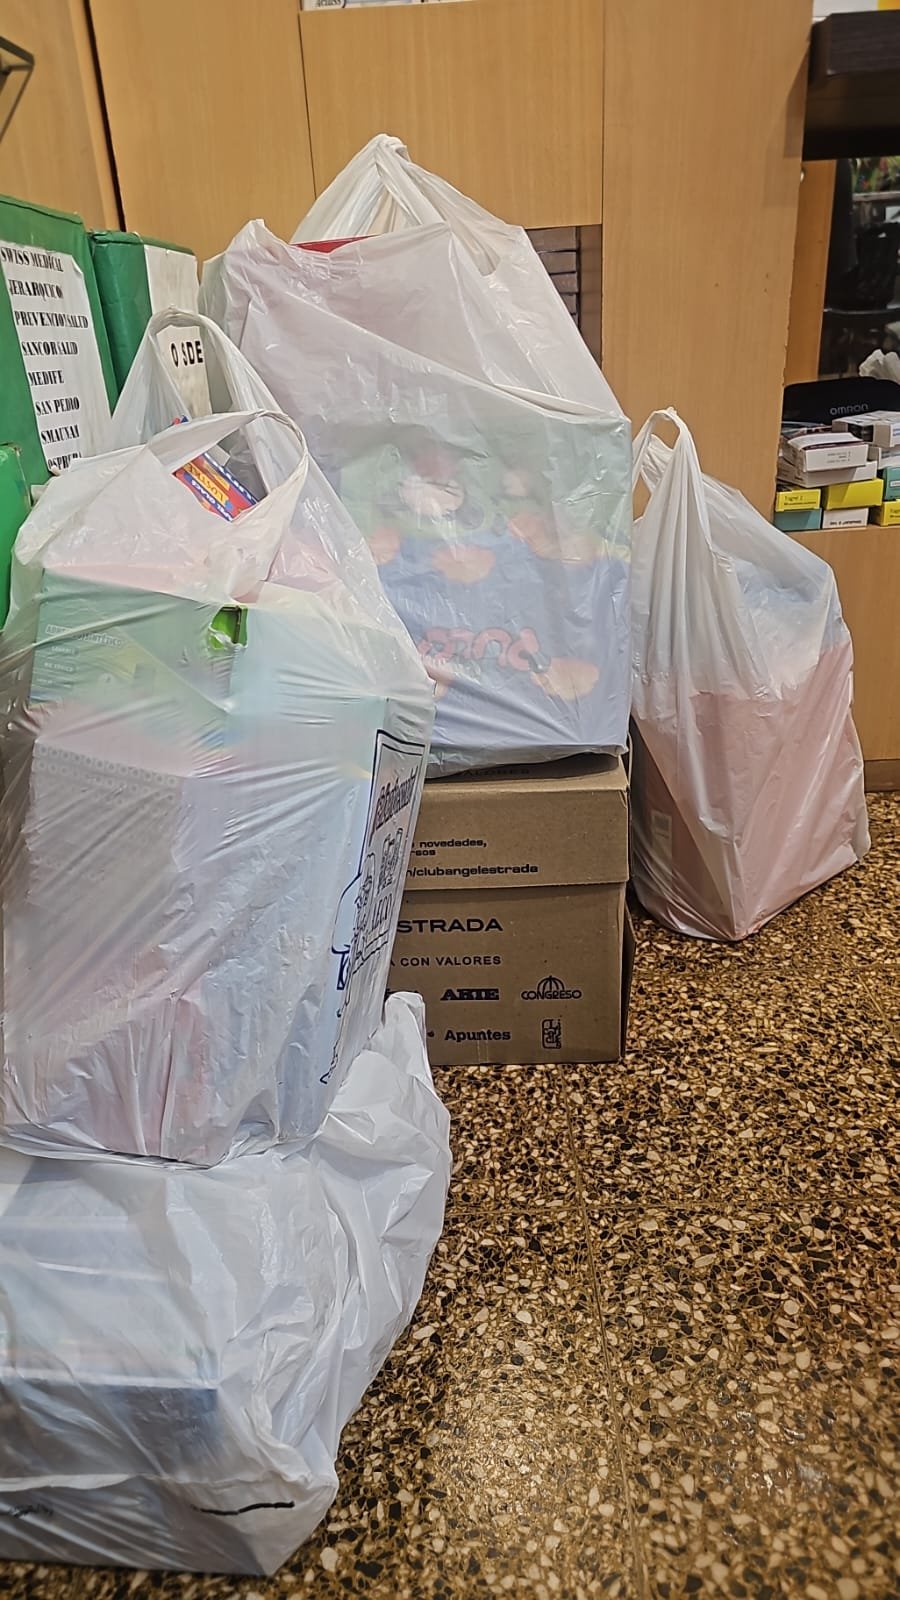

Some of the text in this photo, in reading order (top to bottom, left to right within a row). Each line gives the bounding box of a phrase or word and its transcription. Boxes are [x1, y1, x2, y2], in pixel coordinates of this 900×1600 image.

[1, 247, 64, 272] SWISS MEDICAL
[28, 370, 65, 386] MEDIFE
[36, 397, 81, 416] SAN PEDRO
[829, 403, 869, 416] omron
[419, 839, 488, 849] novedades,
[401, 955, 502, 967] CON VALORES
[521, 988, 582, 1000] CONGRESO
[444, 1029, 511, 1042] Apuntes
